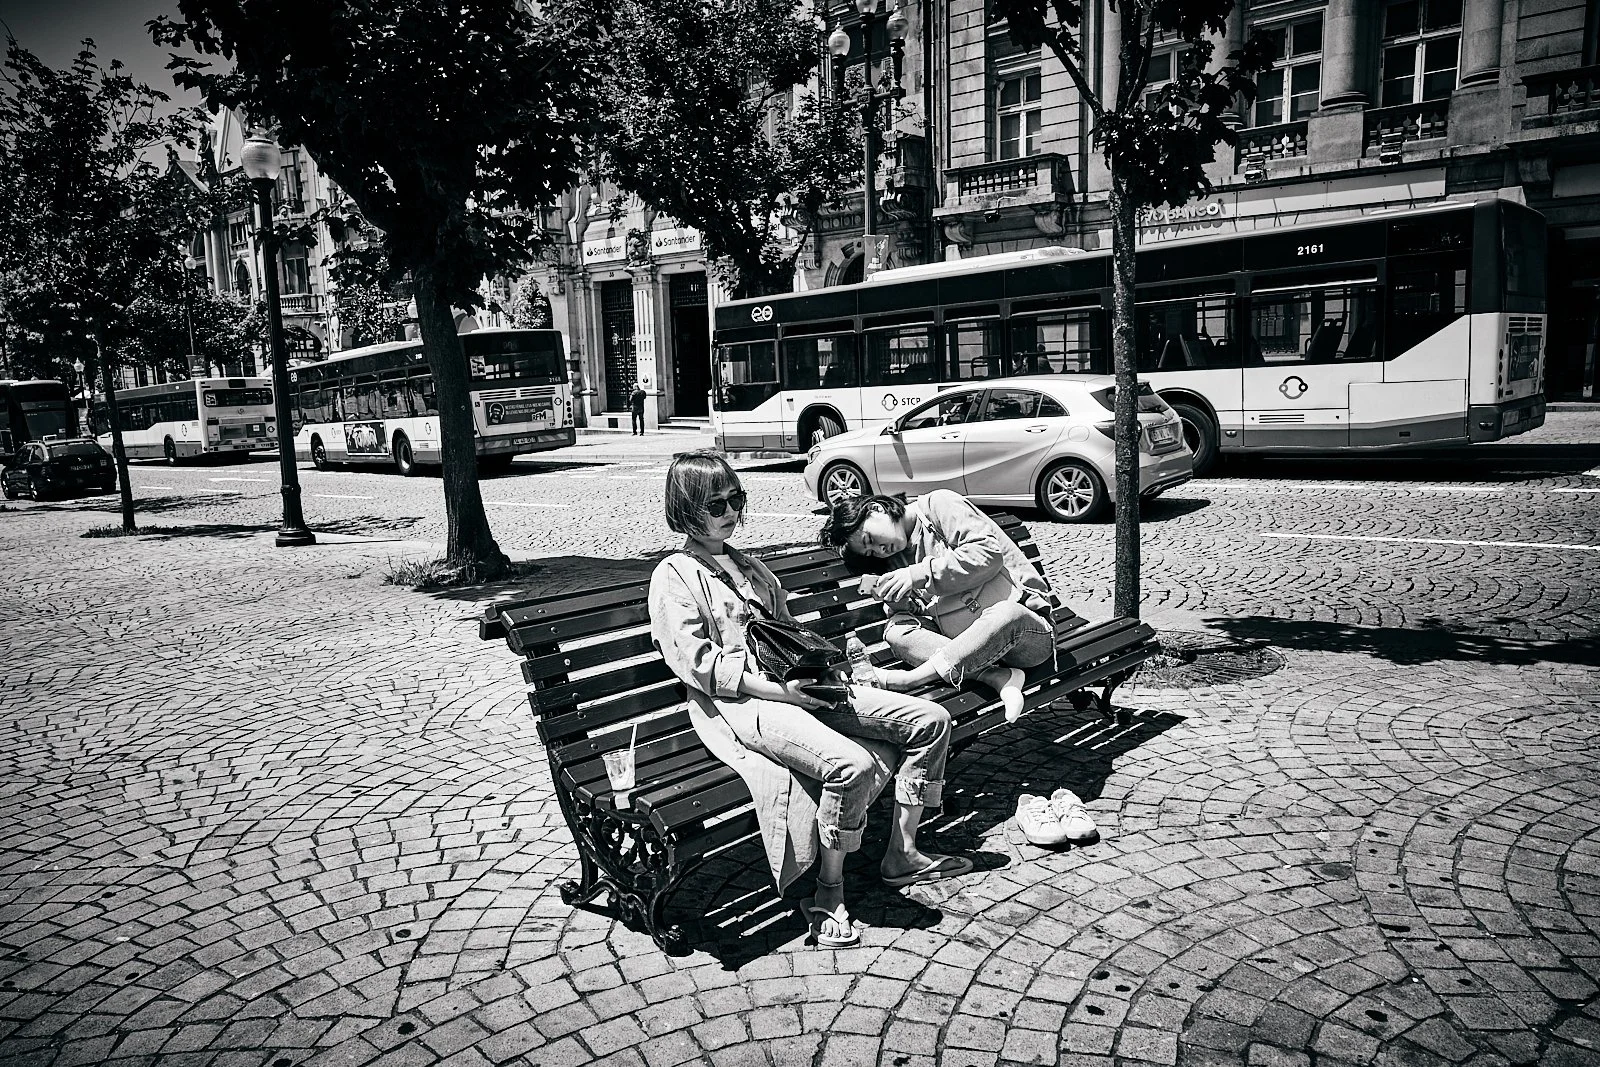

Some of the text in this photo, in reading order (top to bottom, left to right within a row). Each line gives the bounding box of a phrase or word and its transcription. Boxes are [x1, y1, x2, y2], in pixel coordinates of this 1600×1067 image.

[664, 234, 696, 247] Santander
[593, 244, 622, 256] Santander
[1297, 243, 1324, 256] 2161
[901, 397, 921, 406] STCP
